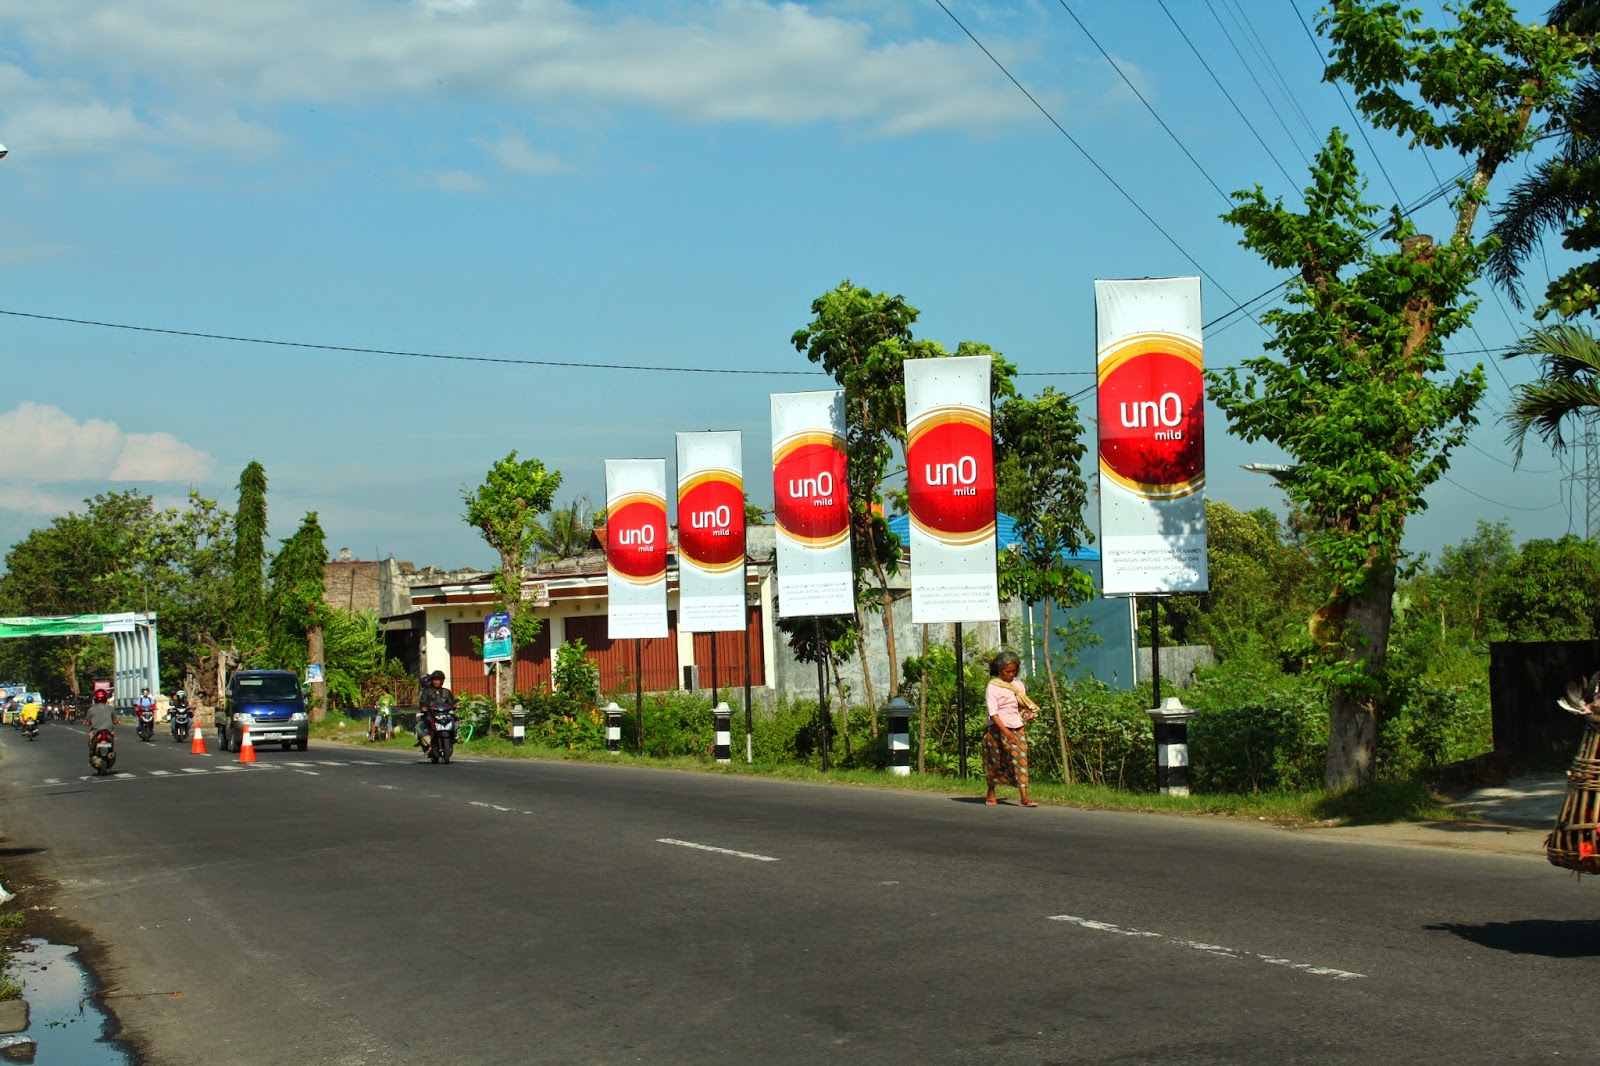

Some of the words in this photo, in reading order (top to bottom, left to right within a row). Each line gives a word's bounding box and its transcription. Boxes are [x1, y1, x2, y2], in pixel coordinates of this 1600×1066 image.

[1154, 429, 1182, 440] mild
[953, 486, 976, 496] mild
[813, 497, 833, 507] mild
[712, 528, 730, 536] mild
